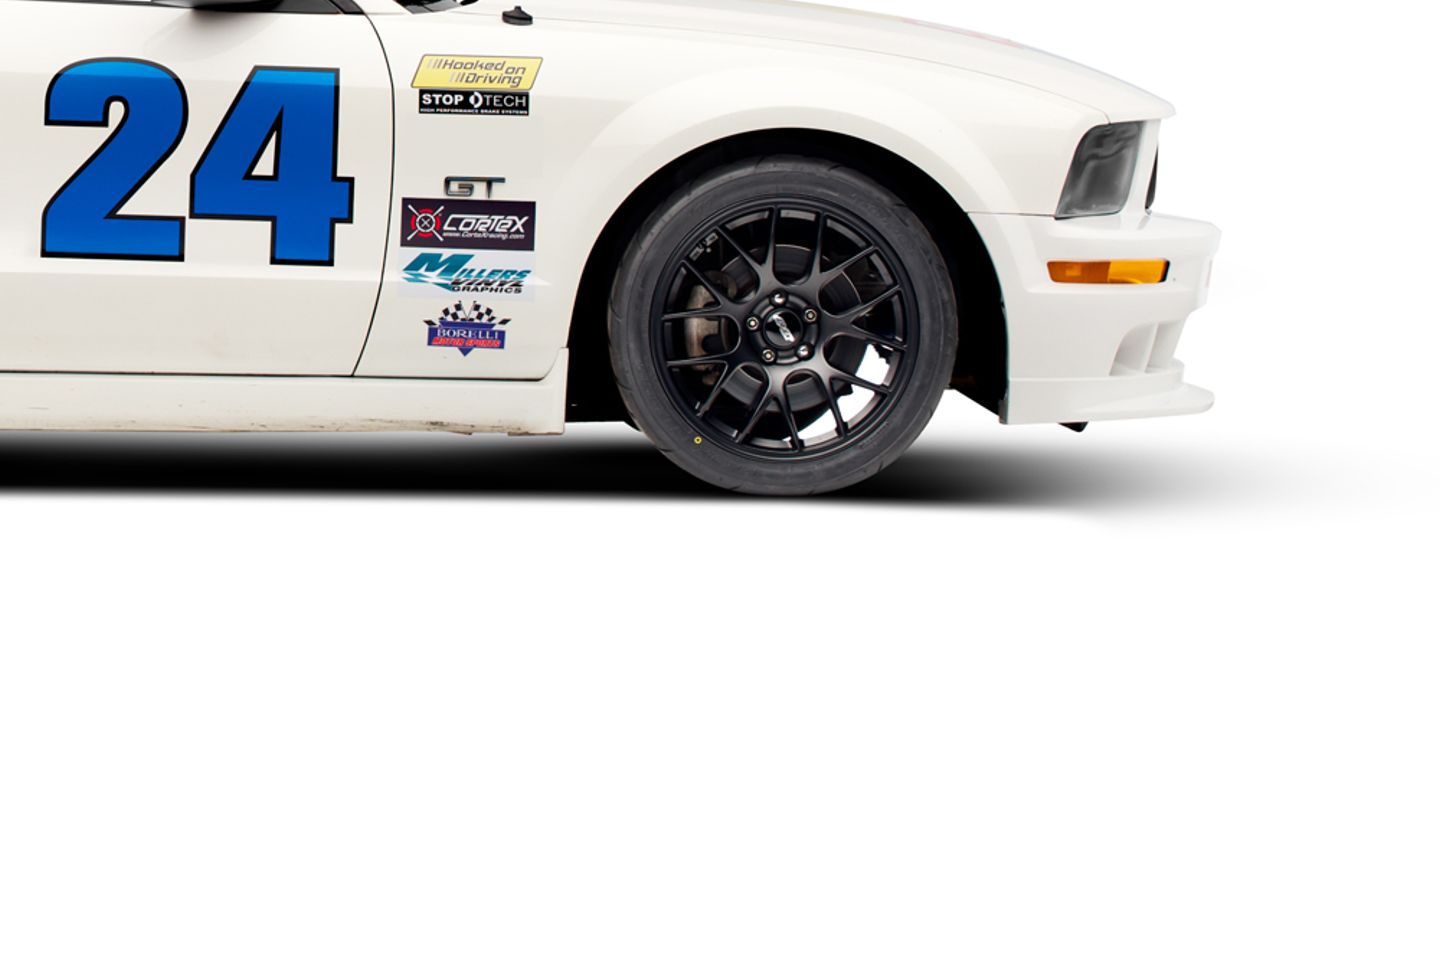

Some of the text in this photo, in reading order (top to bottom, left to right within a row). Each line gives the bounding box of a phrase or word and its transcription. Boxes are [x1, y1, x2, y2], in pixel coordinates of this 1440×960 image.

[441, 59, 526, 76] Hooked on
[465, 72, 523, 88] Driving
[421, 93, 527, 107] STOP TECH
[40, 56, 355, 266] 24
[444, 176, 505, 199] GT
[402, 252, 532, 280] MILLERS
[451, 286, 522, 294] GRAPHICS
[436, 328, 500, 340] BORELLI
